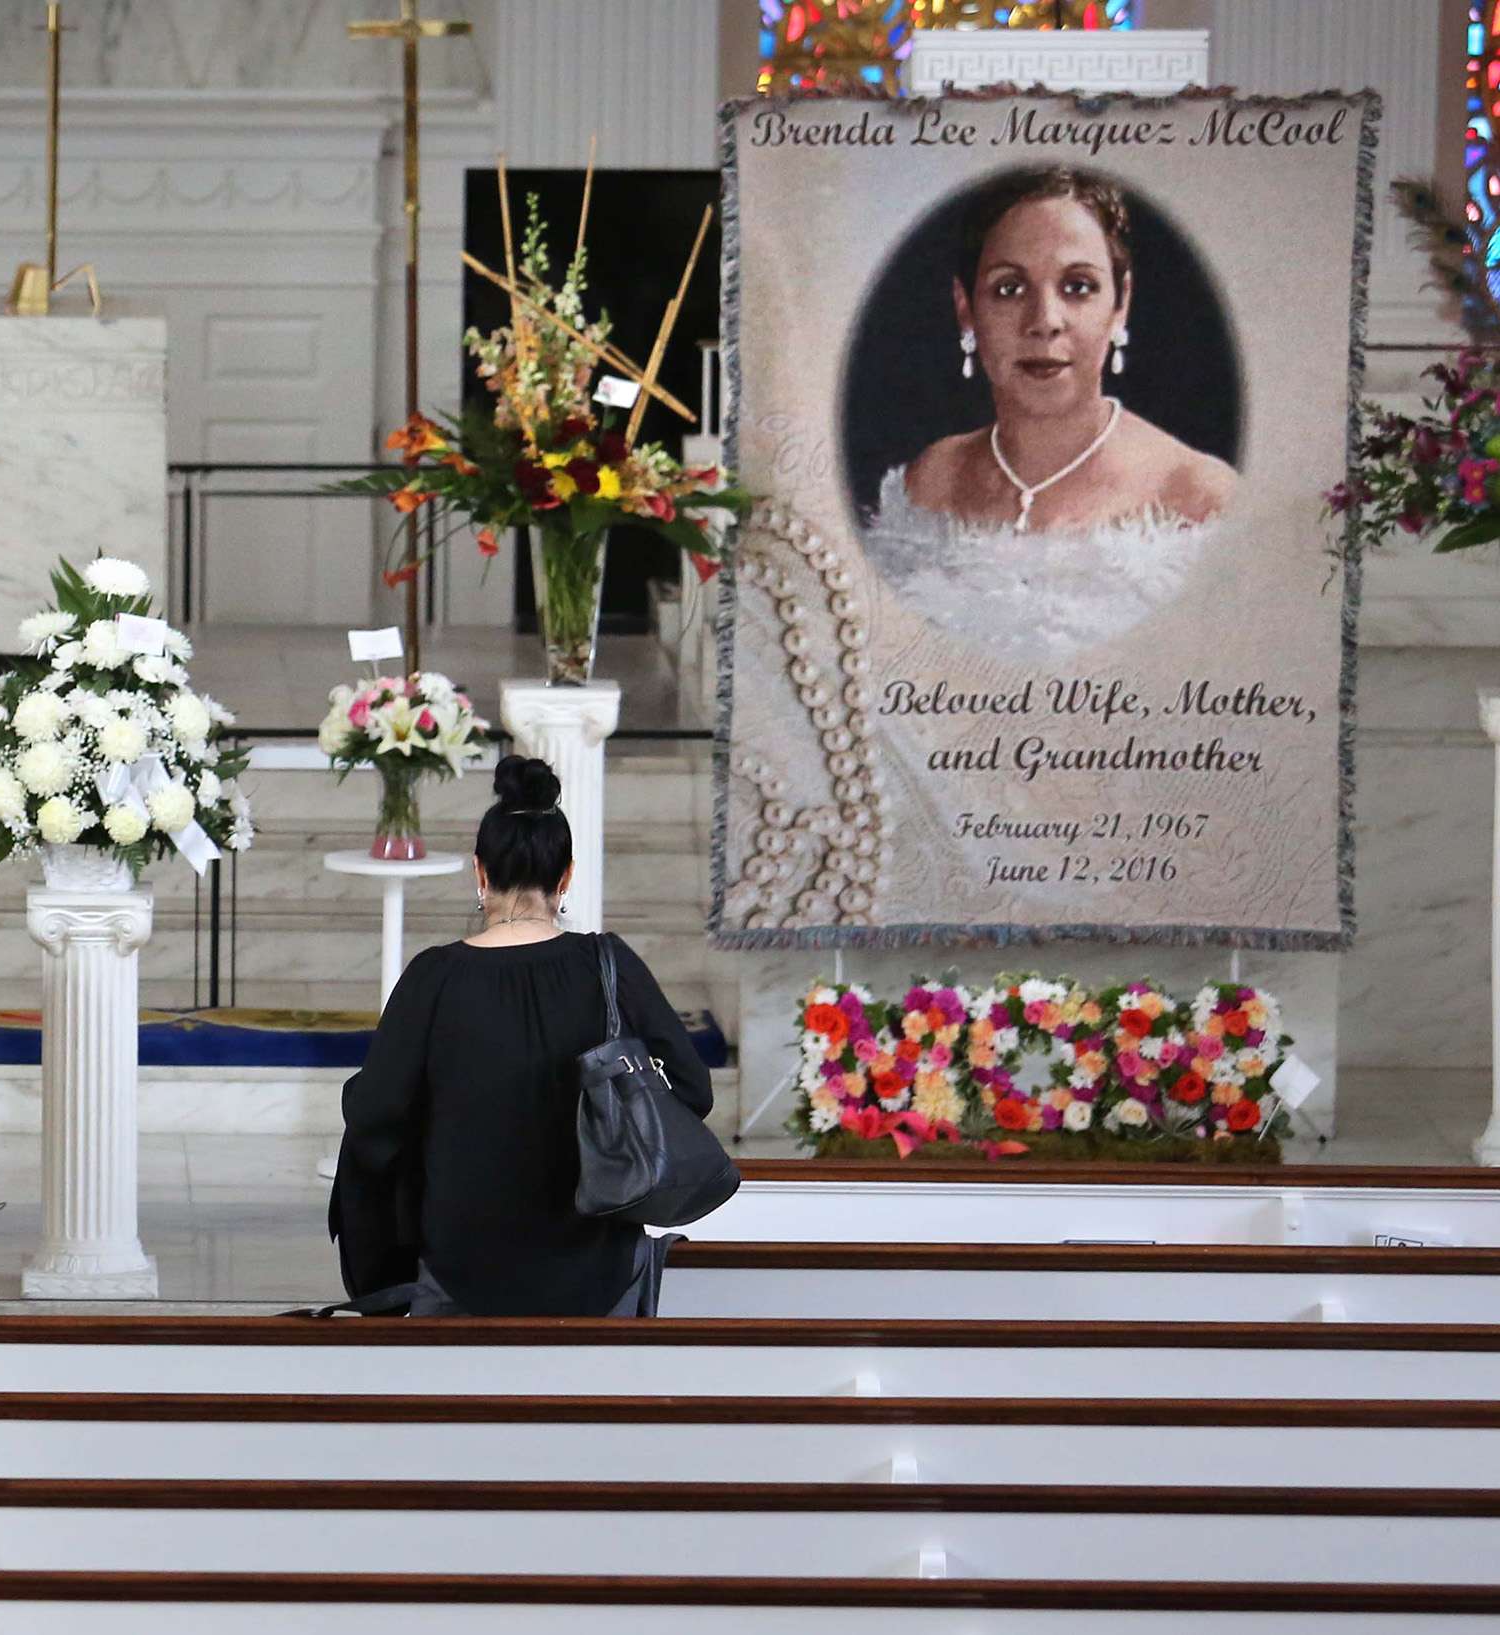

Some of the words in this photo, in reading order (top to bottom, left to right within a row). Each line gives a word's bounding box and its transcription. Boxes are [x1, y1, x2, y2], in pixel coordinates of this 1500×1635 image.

[751, 109, 896, 146] Brenda
[911, 107, 978, 146] Lee
[990, 106, 1176, 155] Marquez
[1188, 107, 1348, 147] McCool
[878, 679, 1035, 716] Beloved
[1045, 679, 1150, 725] Wife,
[1163, 680, 1317, 723] Mother,
[927, 736, 1002, 771] and
[1013, 736, 1264, 782] Grandmother
[952, 813, 1080, 846] February
[1092, 813, 1132, 842] 21,
[1140, 813, 1210, 840] 1967
[982, 856, 1049, 889] June
[1058, 856, 1100, 886] 12,
[1108, 857, 1178, 882] 2016
